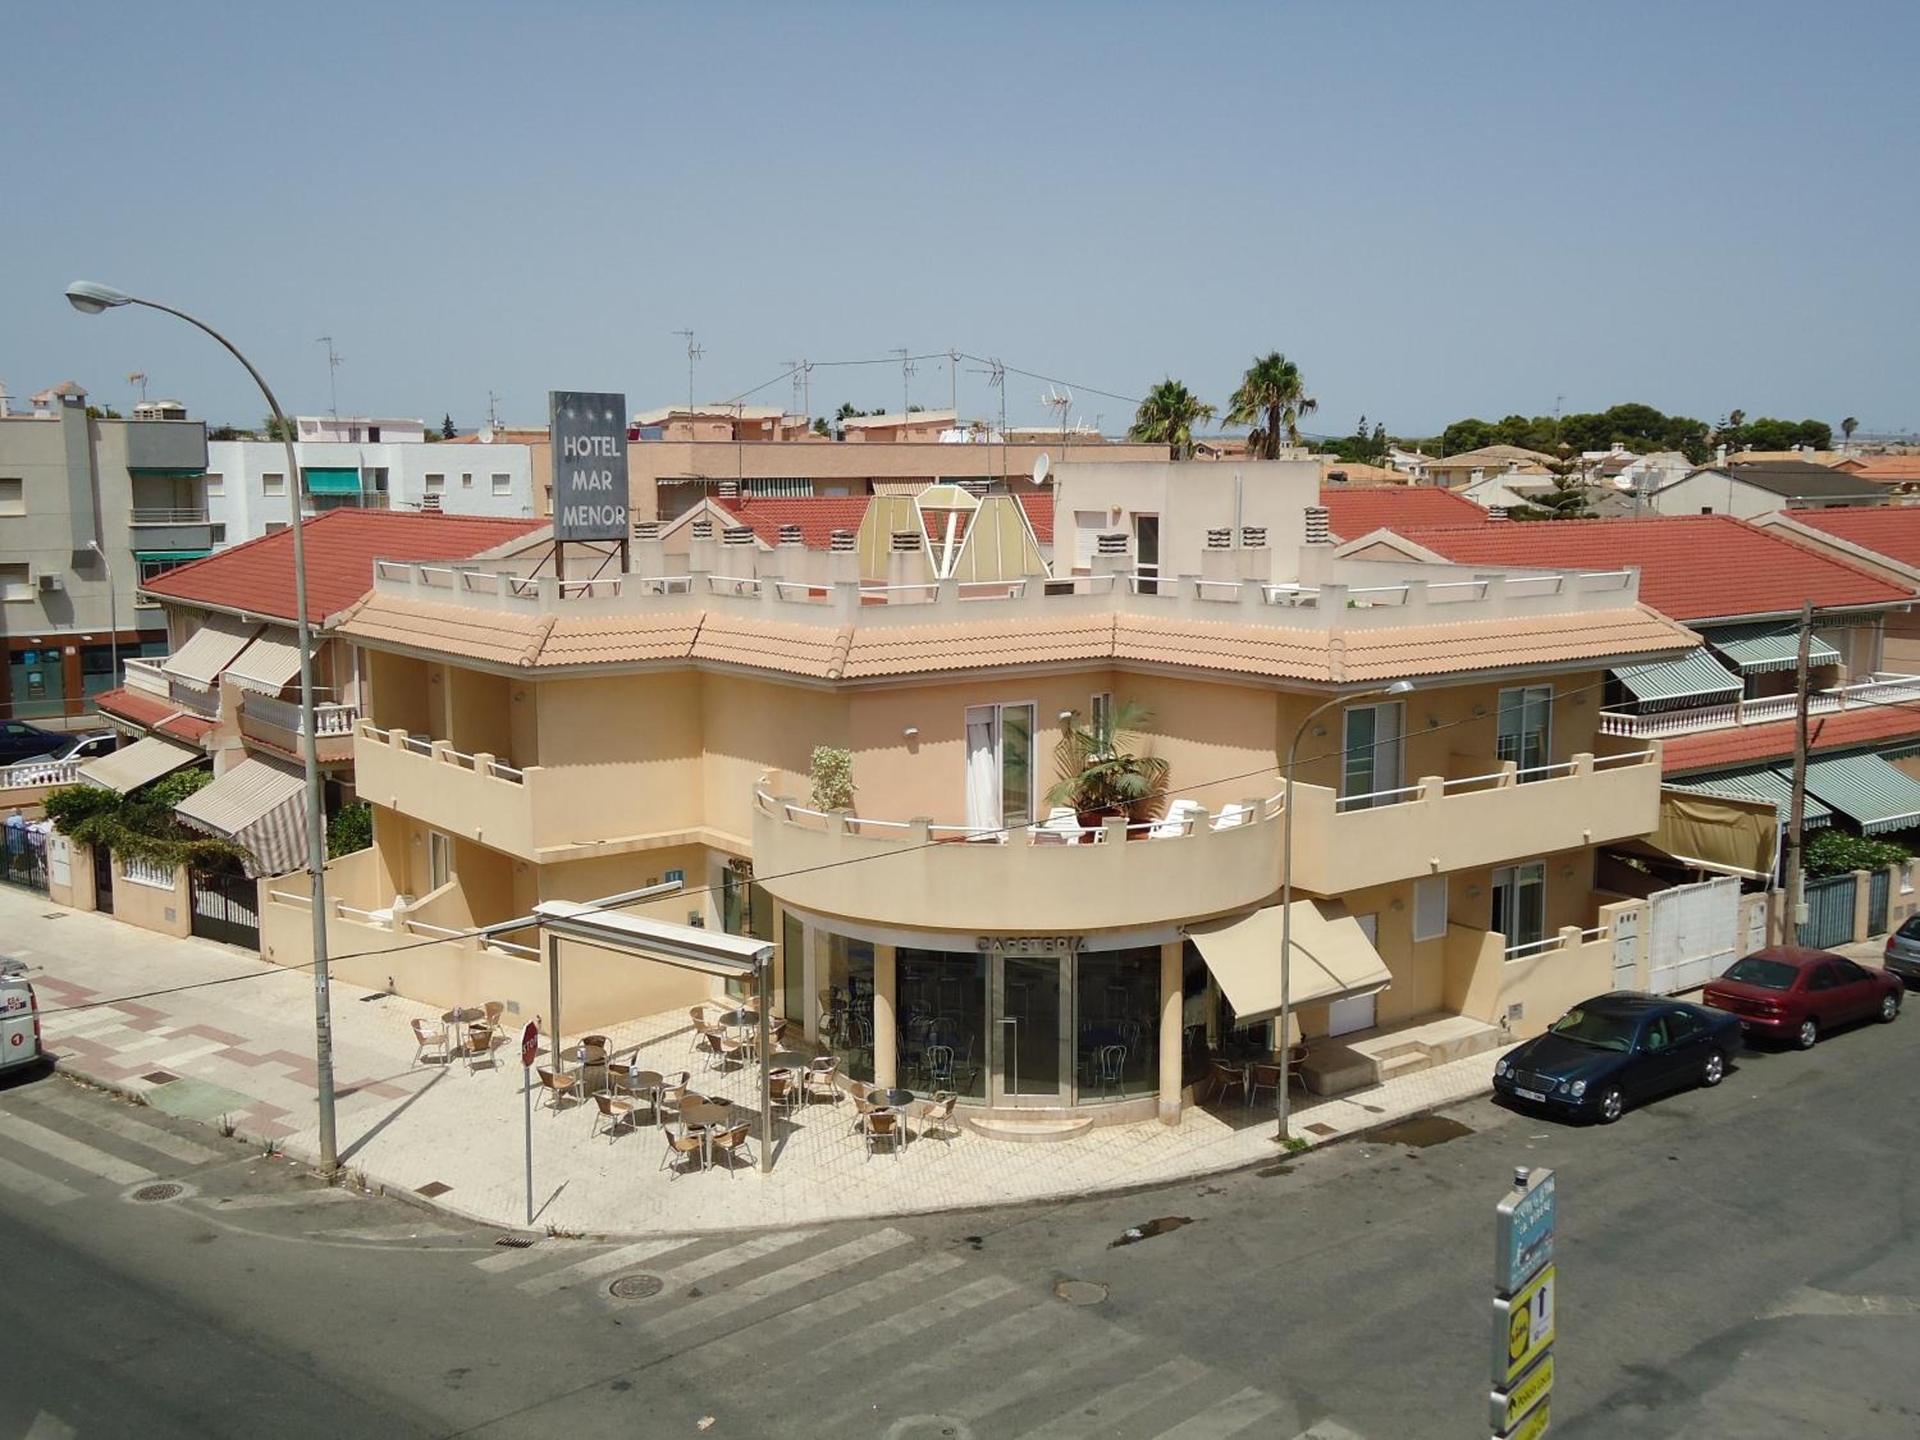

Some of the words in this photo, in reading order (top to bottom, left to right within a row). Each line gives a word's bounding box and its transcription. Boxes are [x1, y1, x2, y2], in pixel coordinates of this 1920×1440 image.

[564, 436, 621, 456] HOTEL
[572, 470, 613, 491] MAR
[563, 505, 626, 527] MENOR
[523, 1034, 537, 1055] STOP
